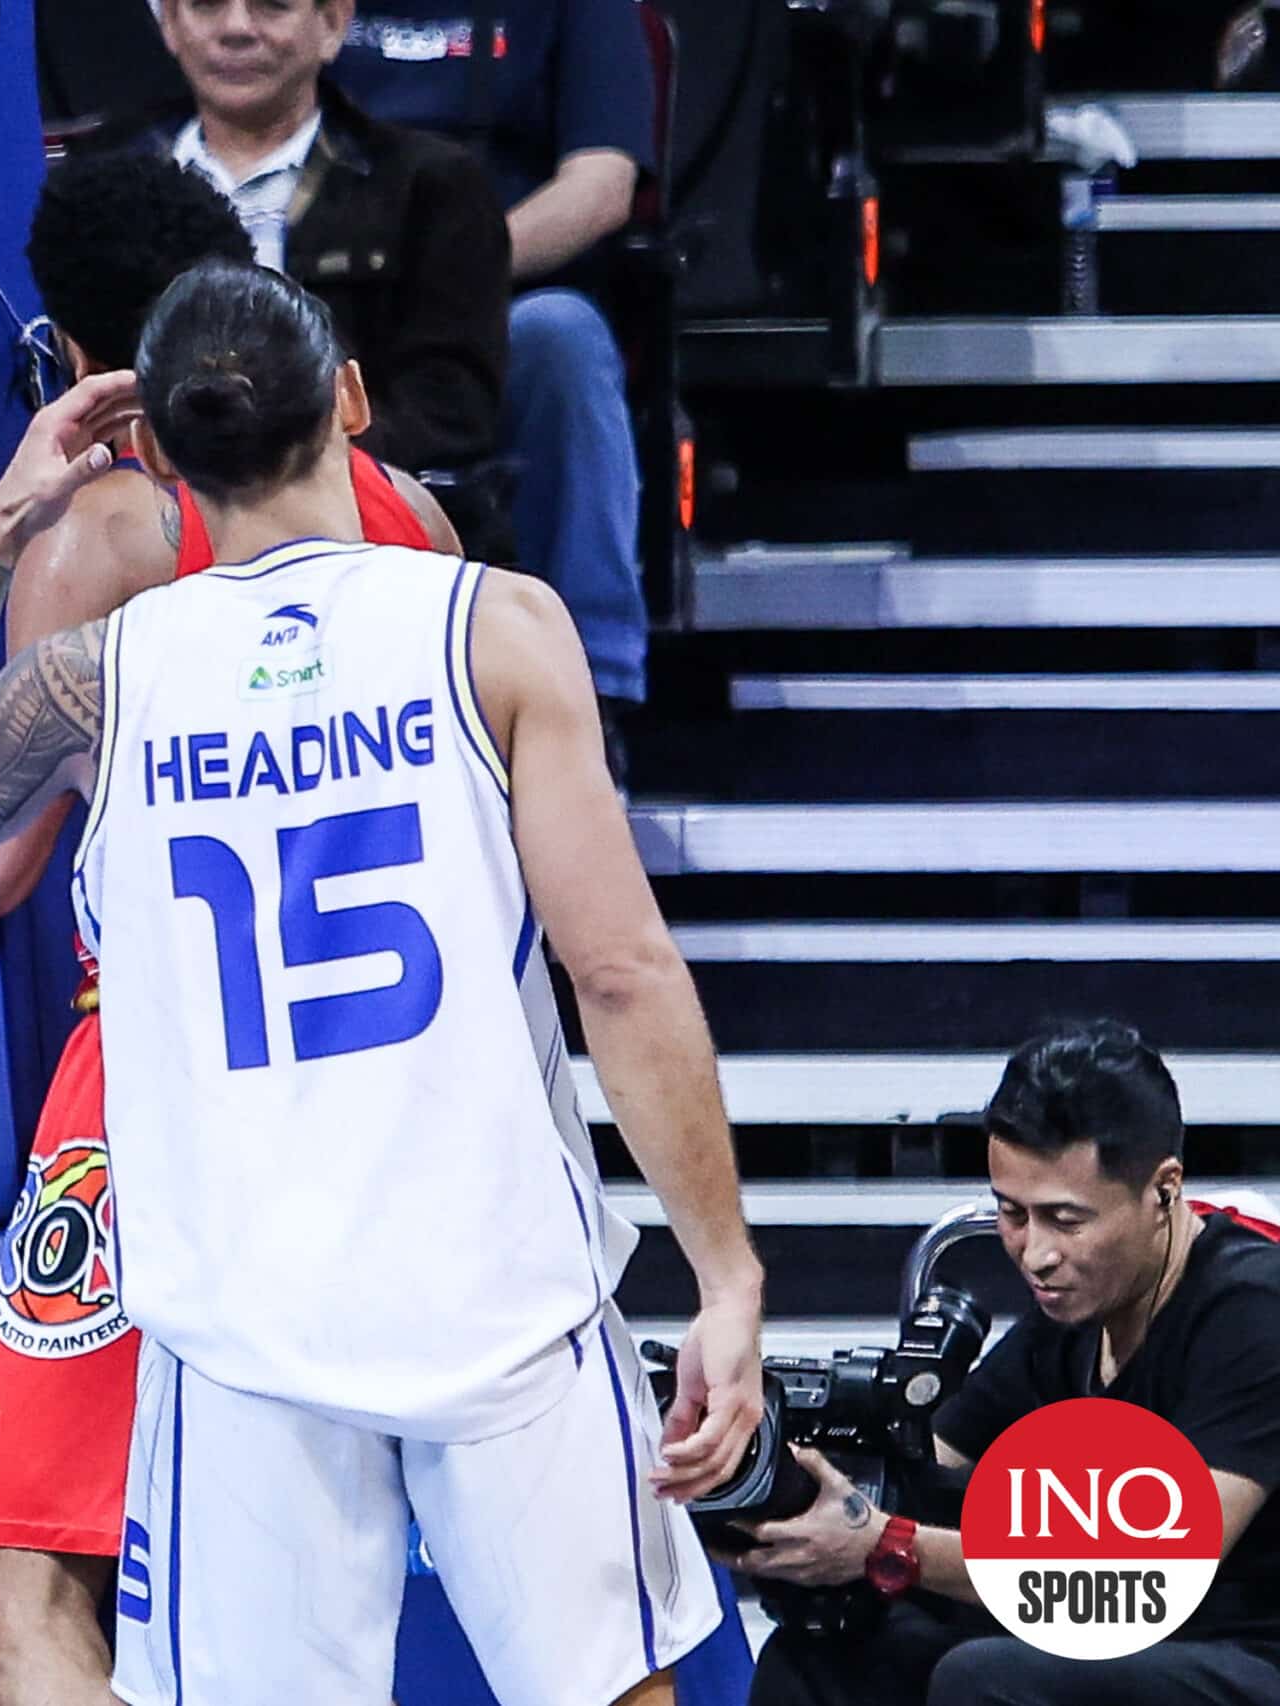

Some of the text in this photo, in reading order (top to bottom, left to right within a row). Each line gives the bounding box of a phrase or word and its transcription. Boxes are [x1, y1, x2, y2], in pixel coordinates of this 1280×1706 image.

[276, 658, 325, 688] Smart
[144, 698, 435, 807] HEADING
[168, 802, 444, 1071] 15
[37, 1312, 130, 1351] PAINTERS
